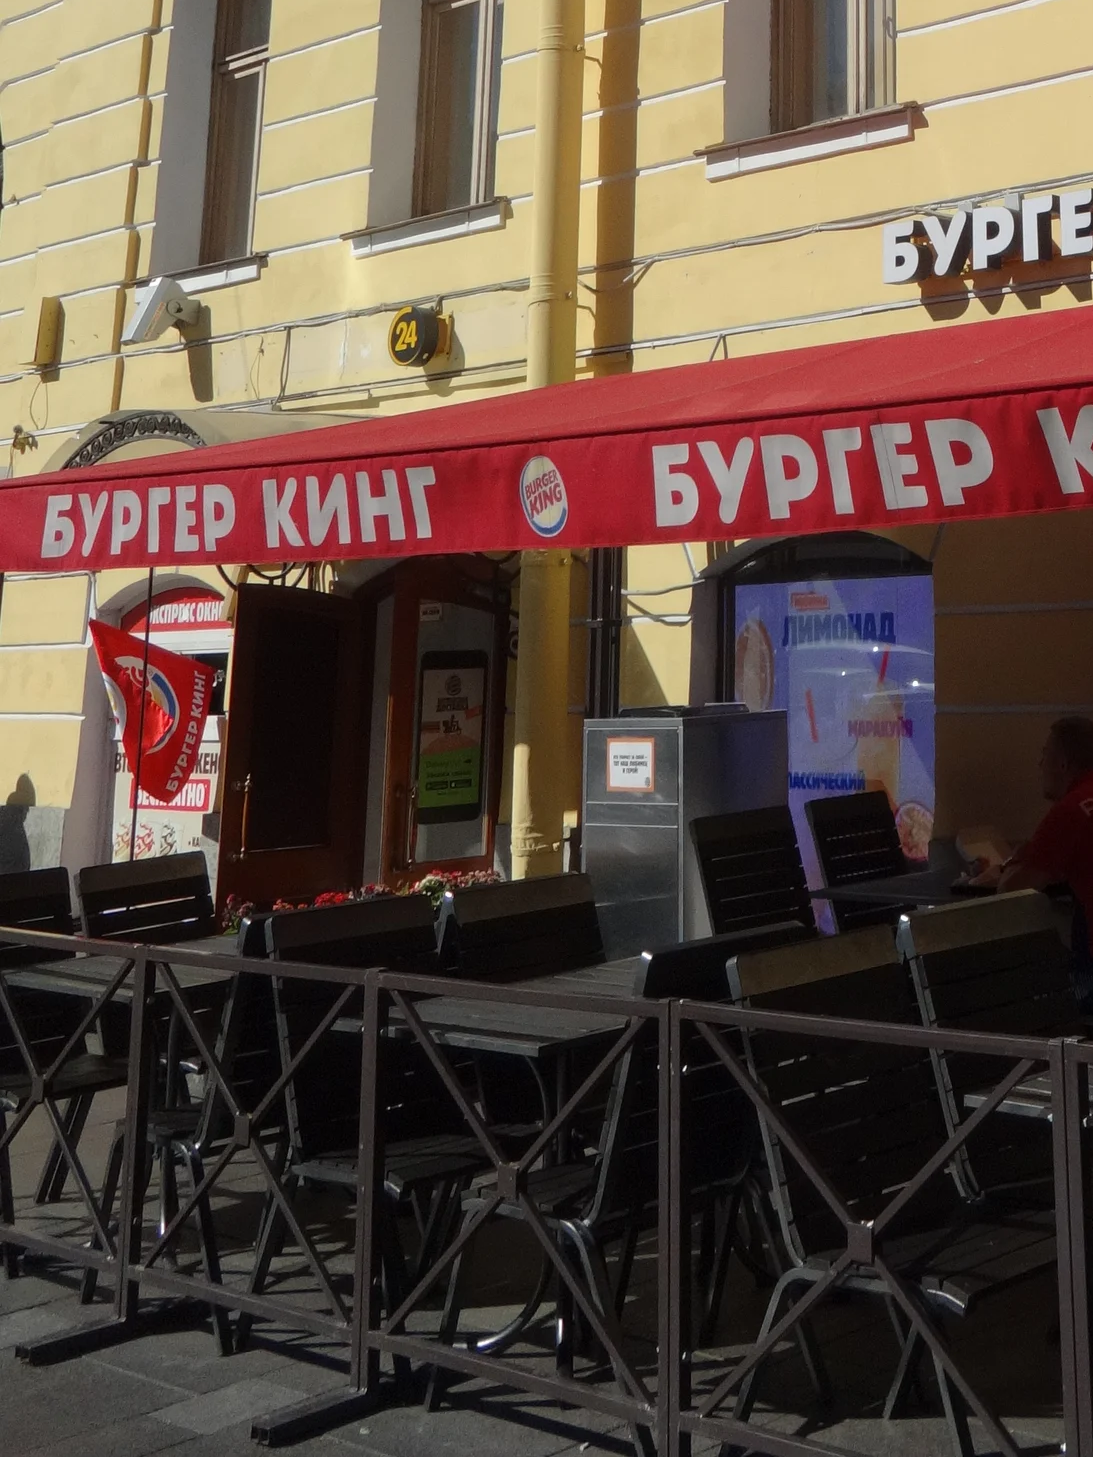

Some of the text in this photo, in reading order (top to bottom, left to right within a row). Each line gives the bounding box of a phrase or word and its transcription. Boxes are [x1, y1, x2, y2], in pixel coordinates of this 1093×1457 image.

[394, 320, 418, 352] 24
[524, 469, 559, 501] BURGER
[652, 417, 994, 528] БУРГЕР
[41, 465, 437, 559] БУРГЕР КИНГ
[529, 482, 562, 519] KING
[782, 611, 897, 647] ЛИМОНАД
[165, 670, 207, 793] БУРГЕР КИНГ
